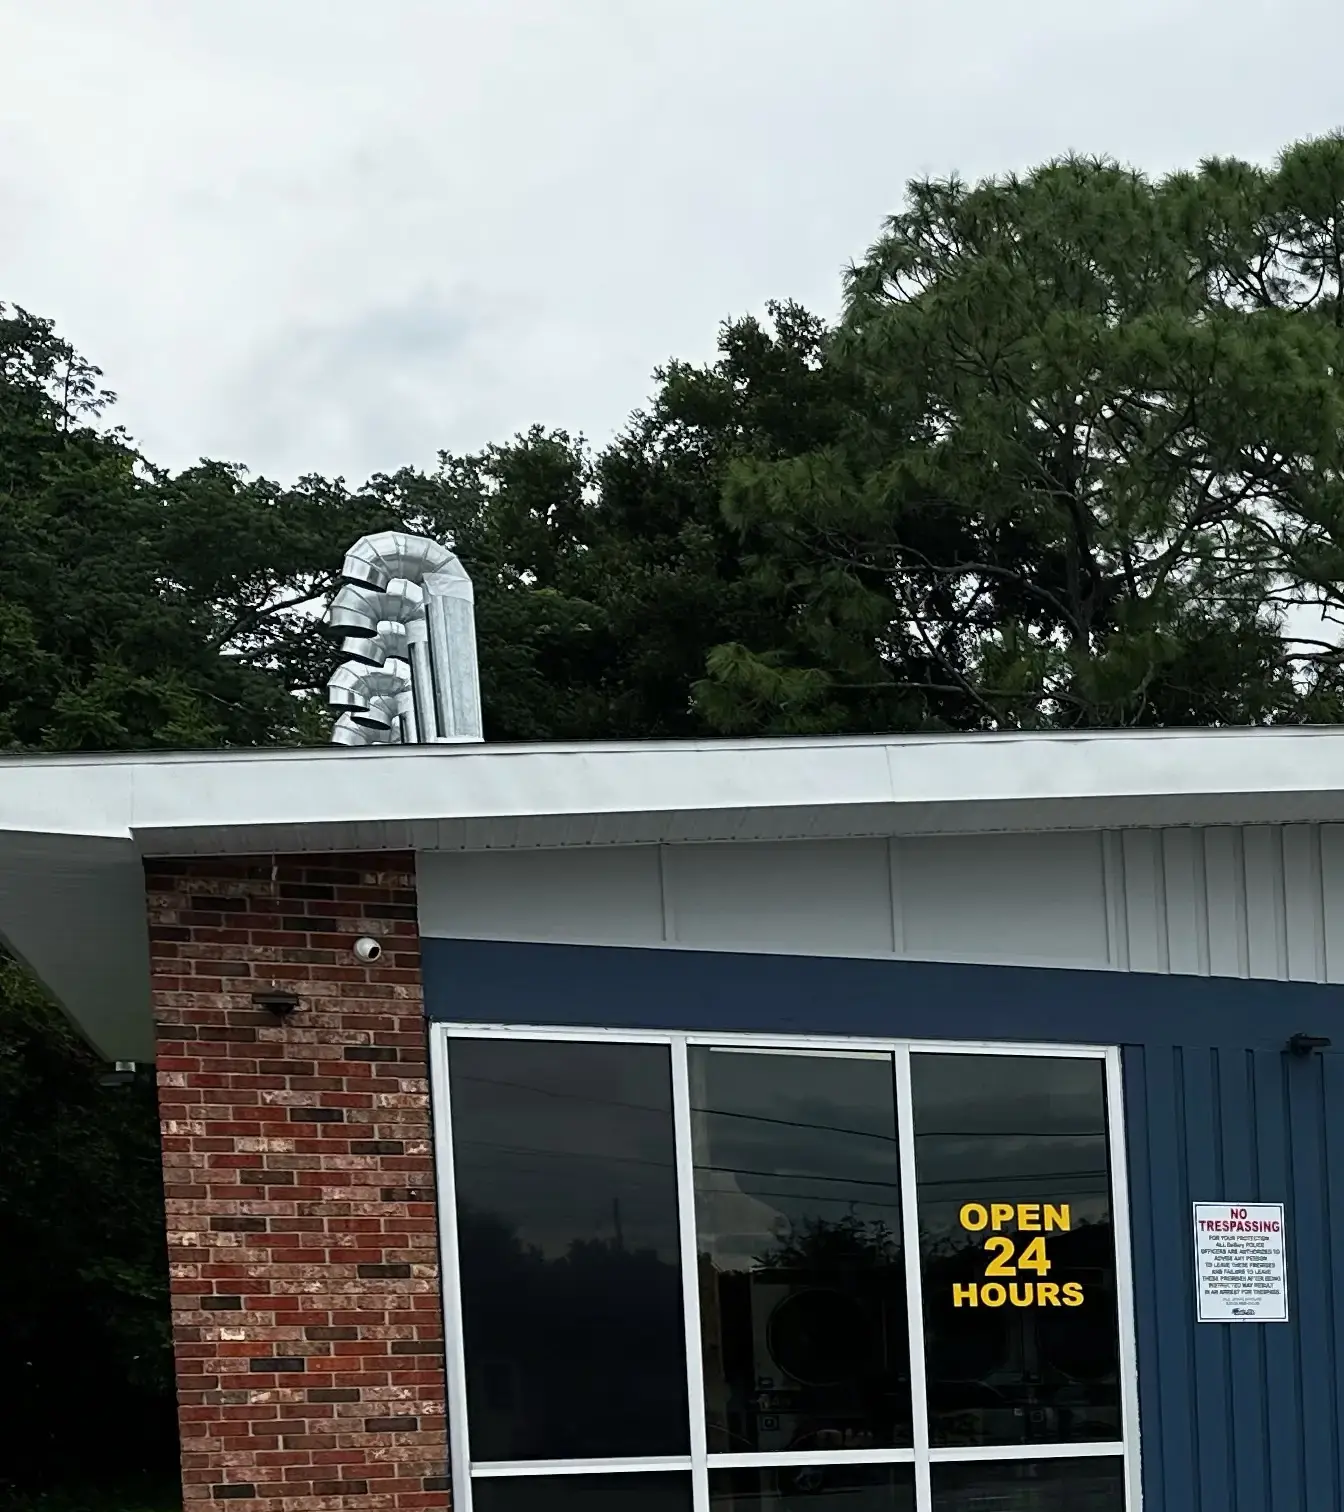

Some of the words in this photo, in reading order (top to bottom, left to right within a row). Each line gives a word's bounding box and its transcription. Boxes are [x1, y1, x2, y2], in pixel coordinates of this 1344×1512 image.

[960, 1203, 1070, 1231] OPEN
[1230, 1208, 1247, 1219] NO
[1199, 1221, 1280, 1232] TRESPASSING
[984, 1237, 1051, 1276] 24
[953, 1283, 1084, 1307] HOURS
